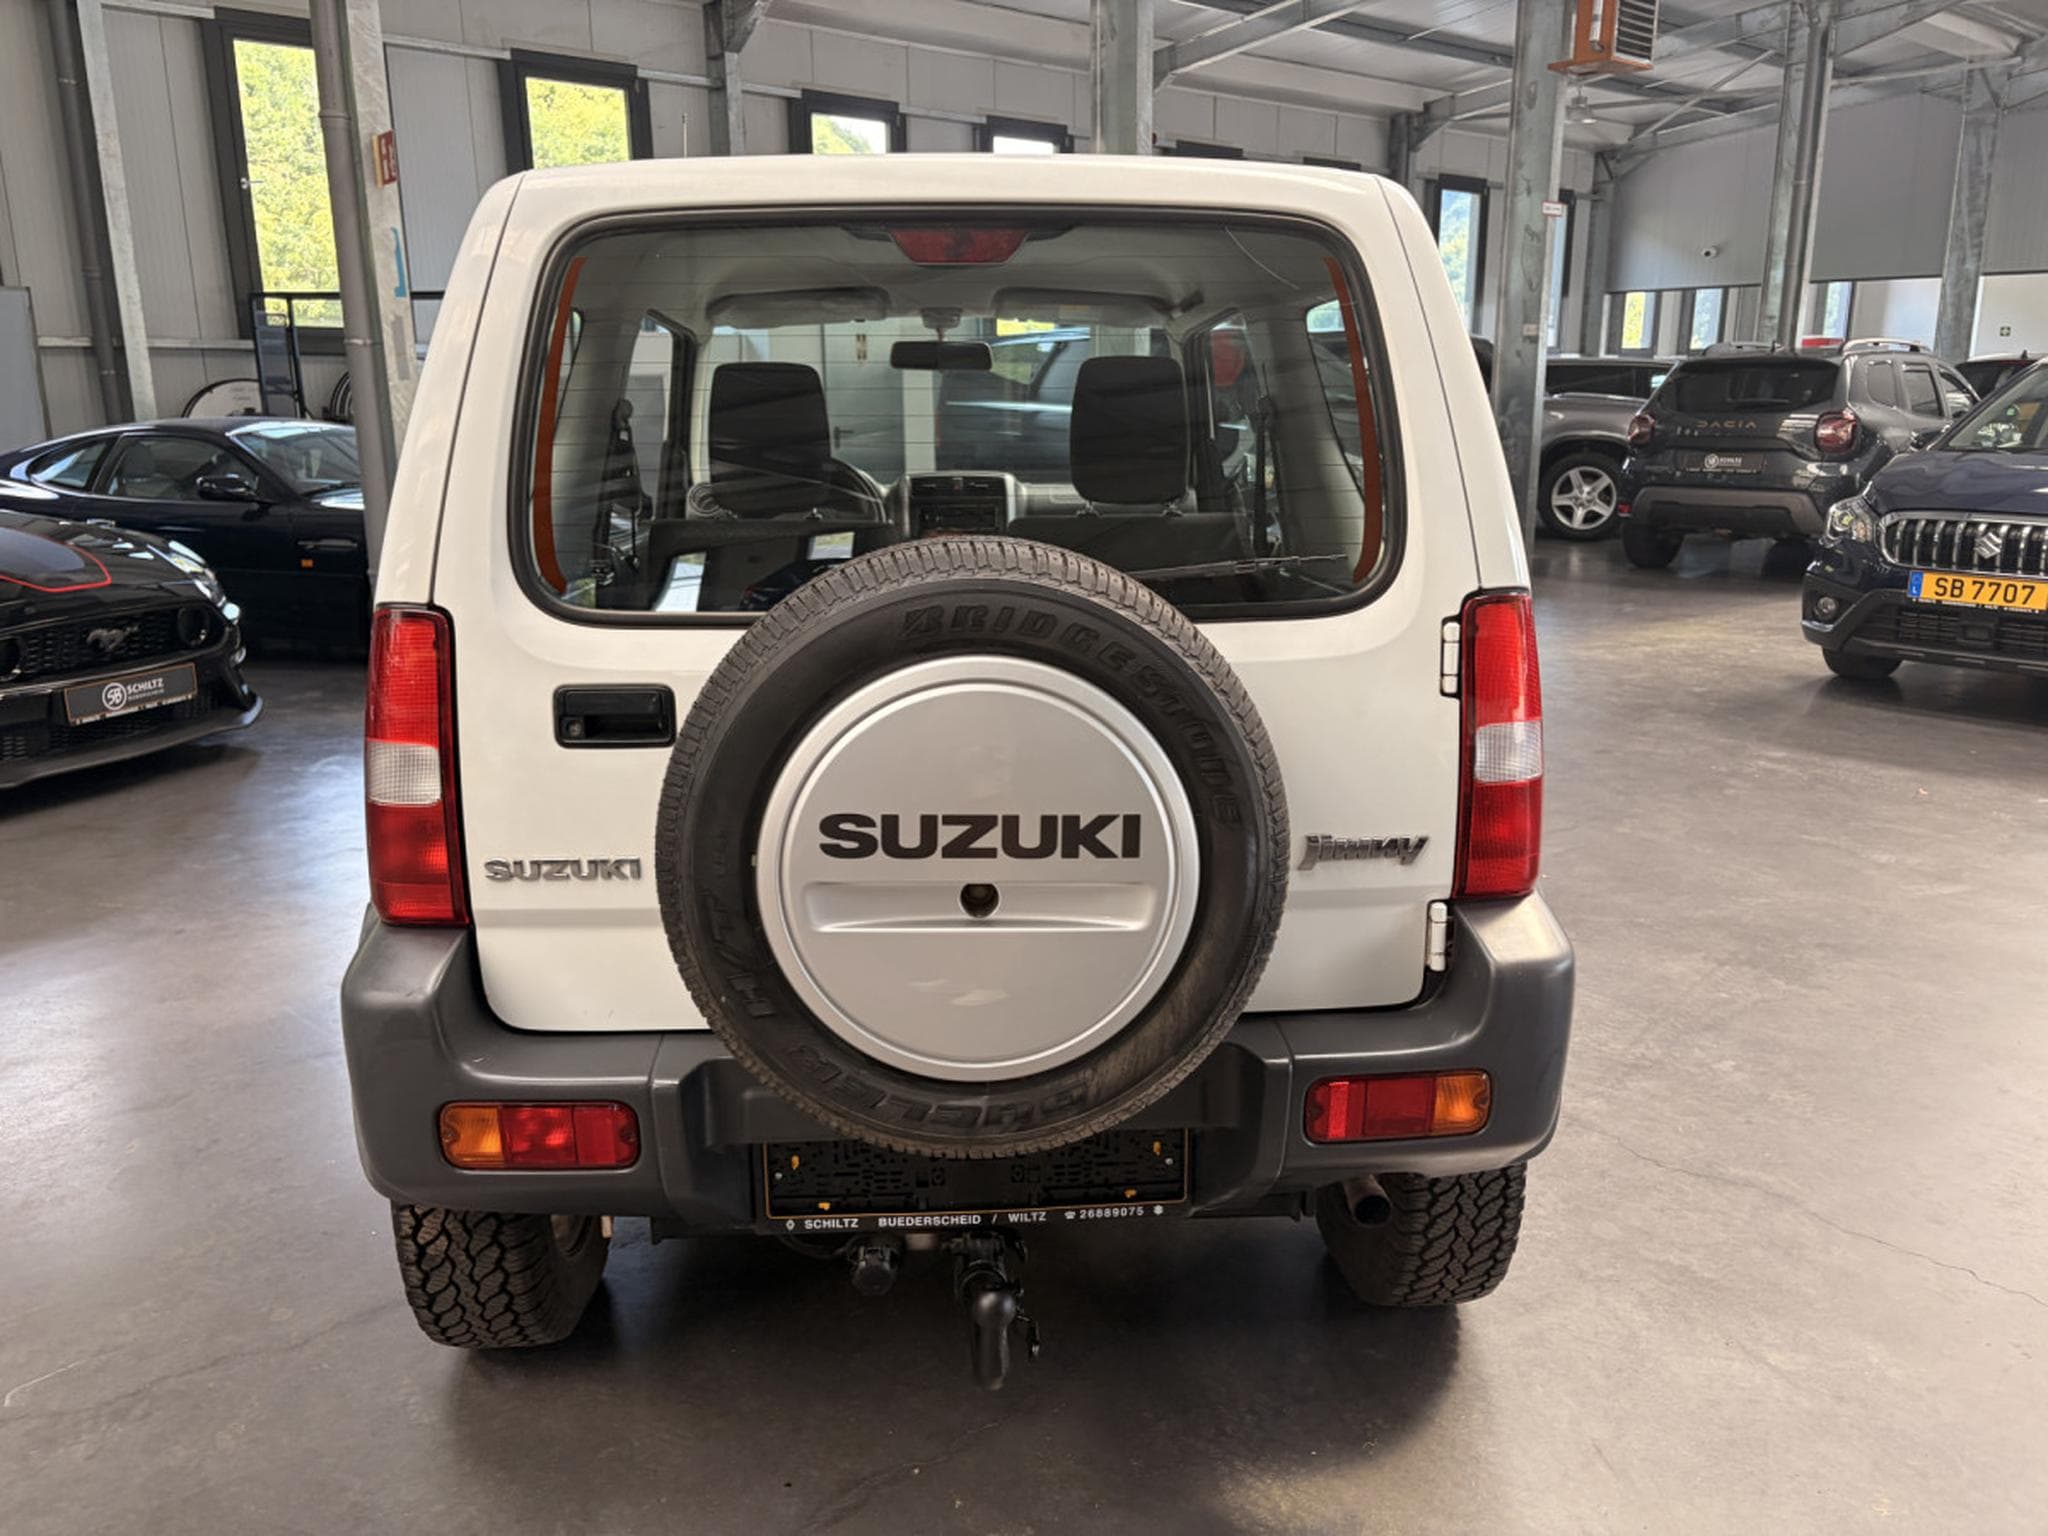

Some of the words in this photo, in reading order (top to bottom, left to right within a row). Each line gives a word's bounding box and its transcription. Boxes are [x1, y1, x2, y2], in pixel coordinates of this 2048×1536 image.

[1696, 420, 1757, 429] DACIA
[1934, 577, 1965, 598] SB
[1972, 580, 2036, 605] 7707
[126, 678, 164, 695] SCHILTZ
[901, 604, 1242, 832] BRIDGESTONE
[819, 813, 1142, 860] SUZUKI
[485, 858, 641, 882] SUZUKI
[804, 1218, 859, 1230] SCHILTZ
[878, 1214, 982, 1227] BUEDERSCHEID
[1008, 1211, 1047, 1223] WILTZ
[1079, 1206, 1145, 1220] 26889075
